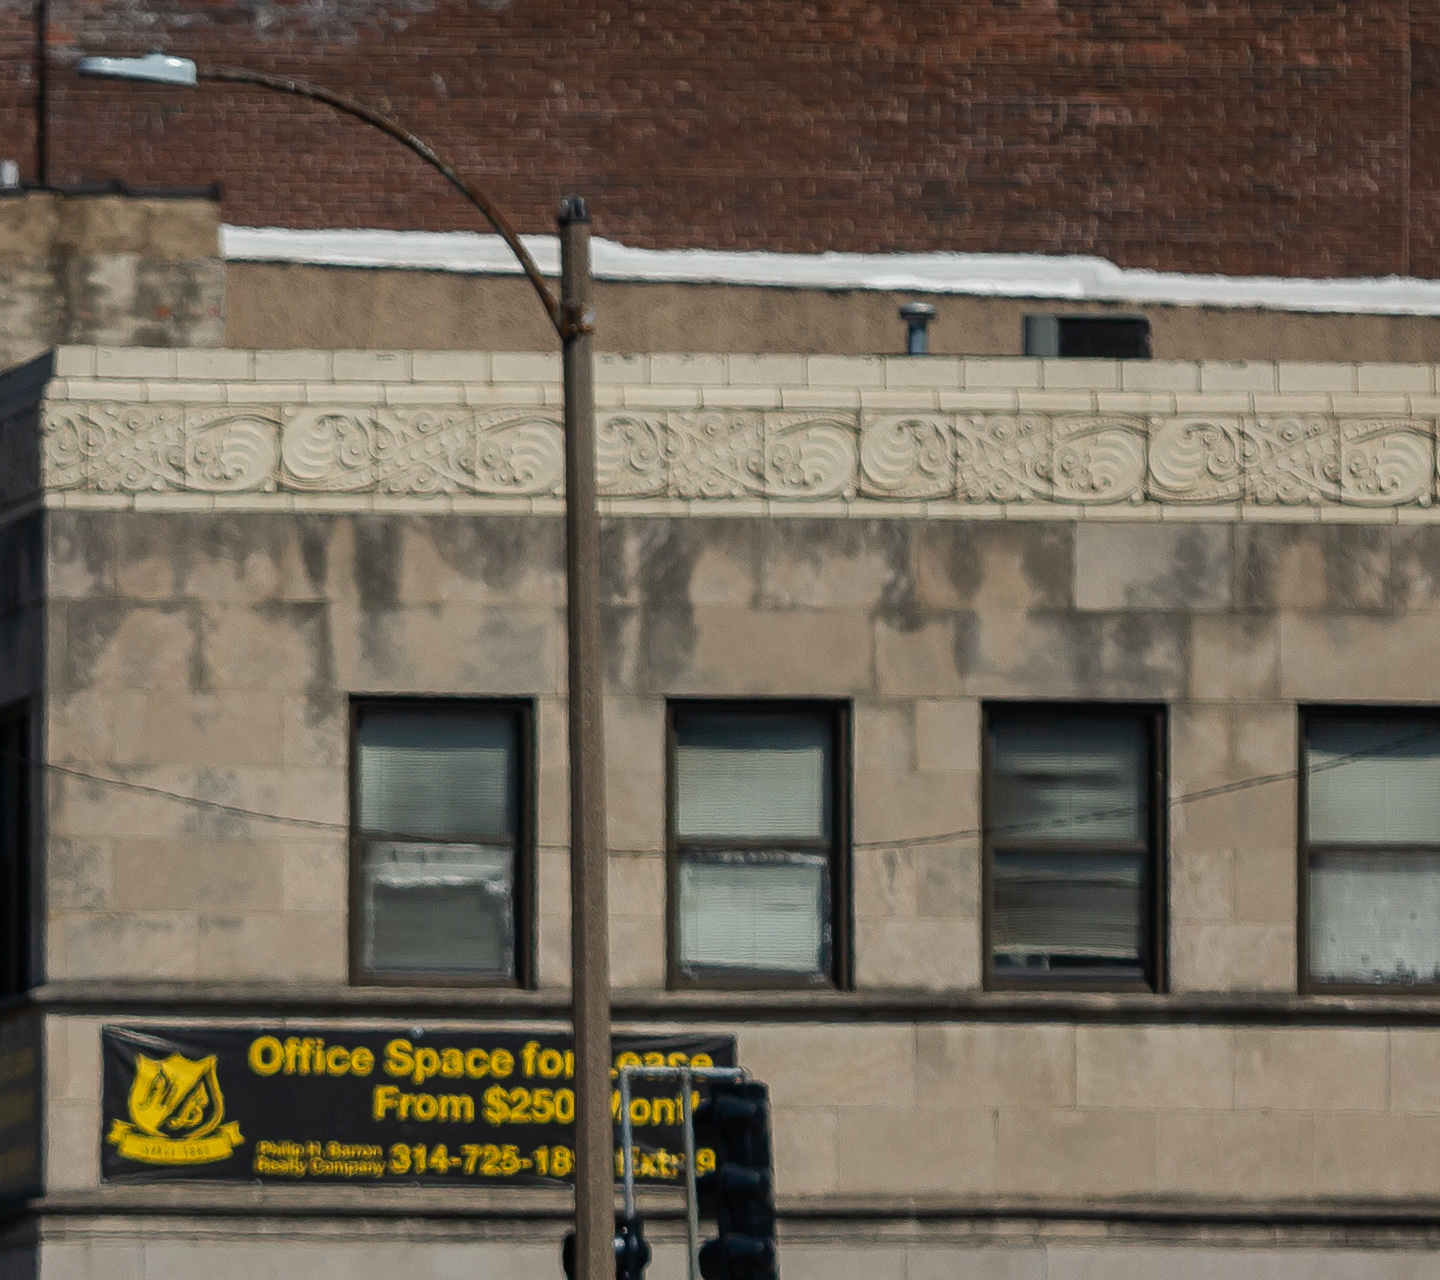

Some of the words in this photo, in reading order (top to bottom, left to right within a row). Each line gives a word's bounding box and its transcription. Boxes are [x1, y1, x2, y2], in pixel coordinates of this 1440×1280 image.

[248, 1036, 375, 1080] Office
[383, 1038, 516, 1086] Space
[522, 1040, 575, 1079] for
[372, 1084, 475, 1123] From
[309, 1156, 386, 1178] Company
[386, 1142, 576, 1177] 314-725-18
